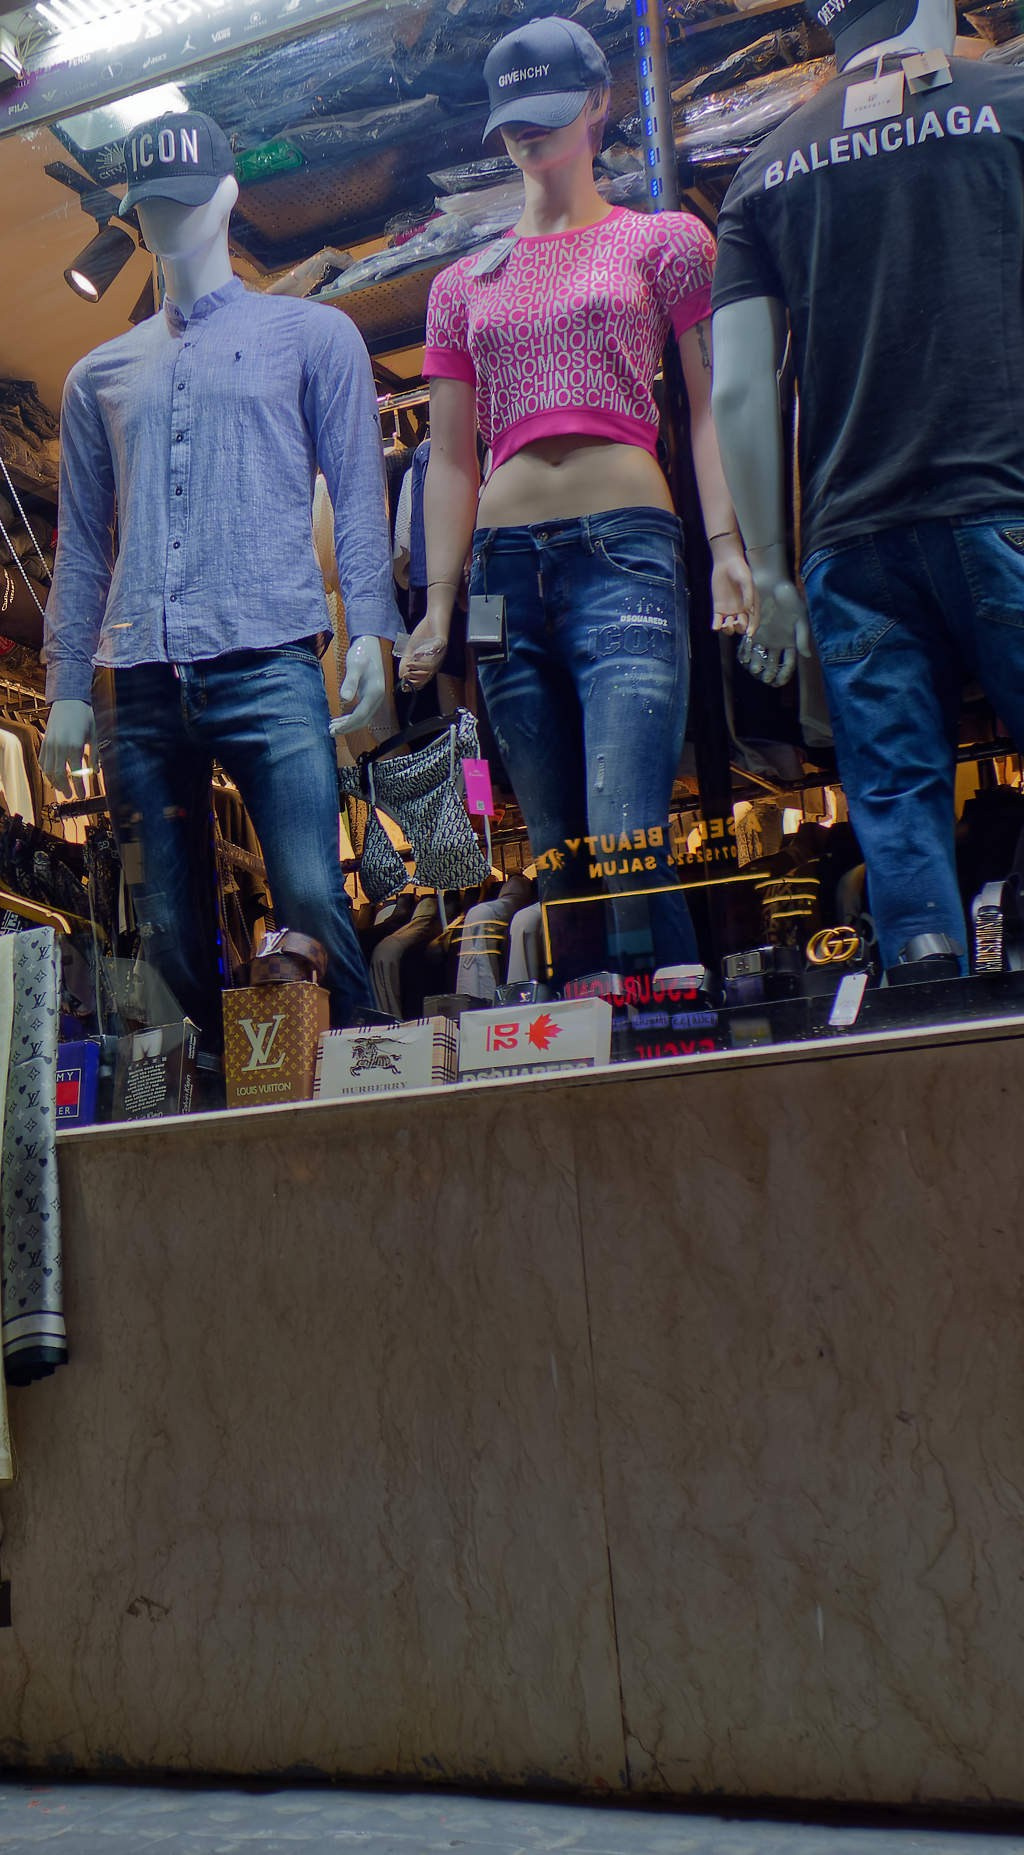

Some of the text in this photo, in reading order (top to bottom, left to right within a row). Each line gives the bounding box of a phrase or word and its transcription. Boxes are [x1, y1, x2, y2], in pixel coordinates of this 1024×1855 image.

[498, 63, 550, 87] GIVENCHY
[8, 102, 29, 116] FILA
[131, 128, 198, 172] ICON
[764, 105, 1002, 191] BALENCIAGA
[238, 1014, 286, 1072] LV
[493, 1022, 520, 1051] D2
[236, 1082, 292, 1096] LOUIS VUITTON
